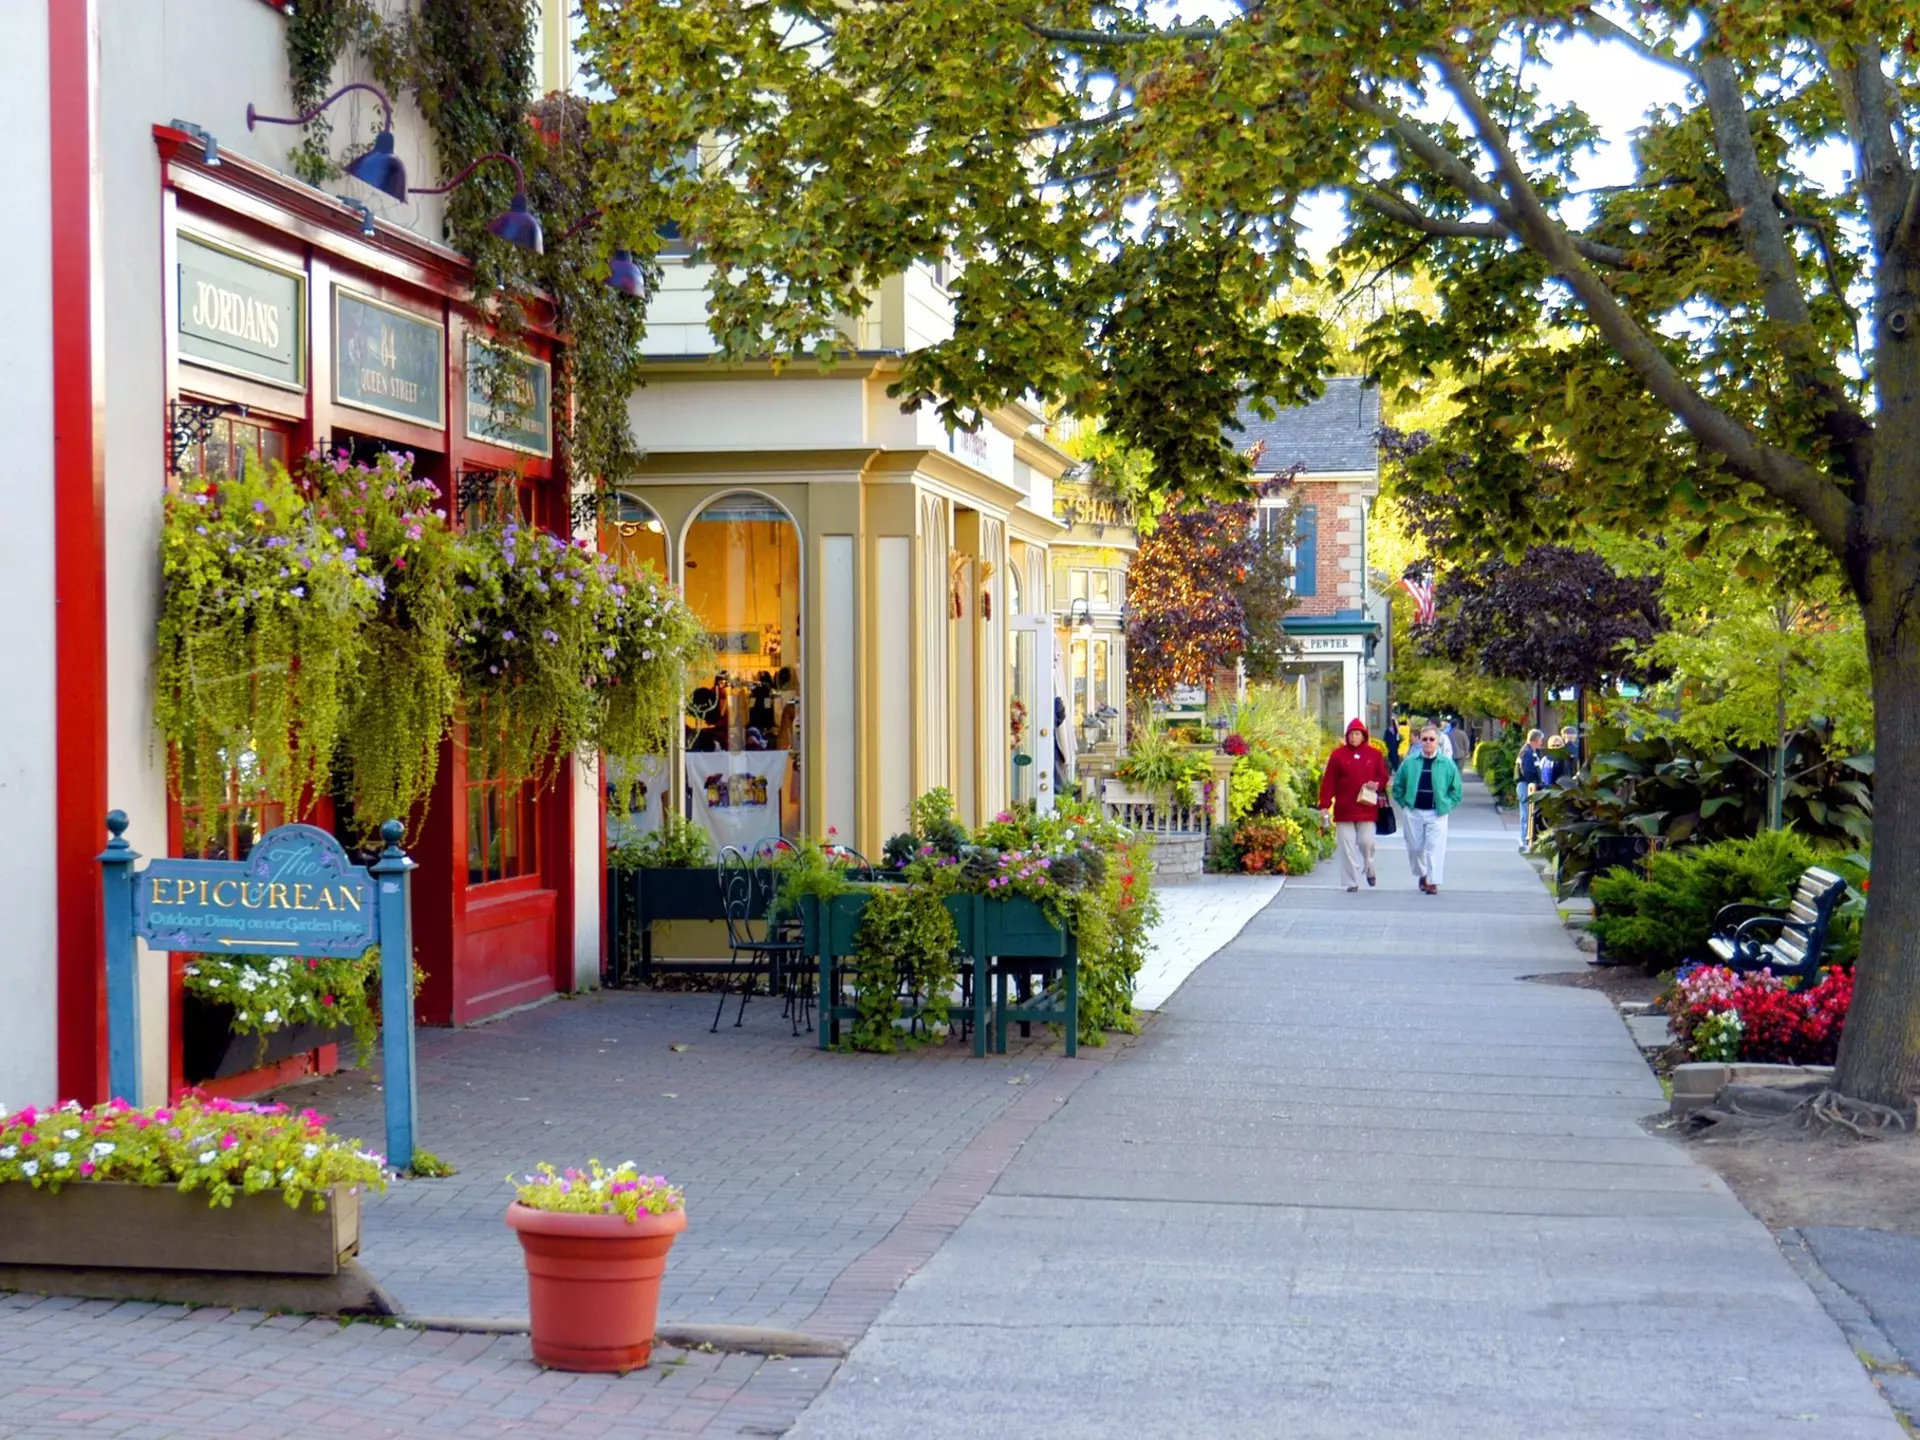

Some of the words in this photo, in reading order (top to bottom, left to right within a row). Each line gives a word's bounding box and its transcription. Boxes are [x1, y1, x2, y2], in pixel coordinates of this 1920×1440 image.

[193, 280, 279, 349] JORDANS
[381, 323, 397, 370] 84
[361, 367, 388, 396] QUEEN
[391, 376, 418, 404] STREET
[1310, 638, 1349, 649] PEWTER
[250, 846, 320, 902] The
[151, 878, 364, 912] EPICUREAN
[150, 911, 203, 926] Outdoor
[204, 914, 246, 931] Dining
[247, 919, 263, 929] on
[264, 919, 286, 930] our
[286, 917, 332, 933] Garden
